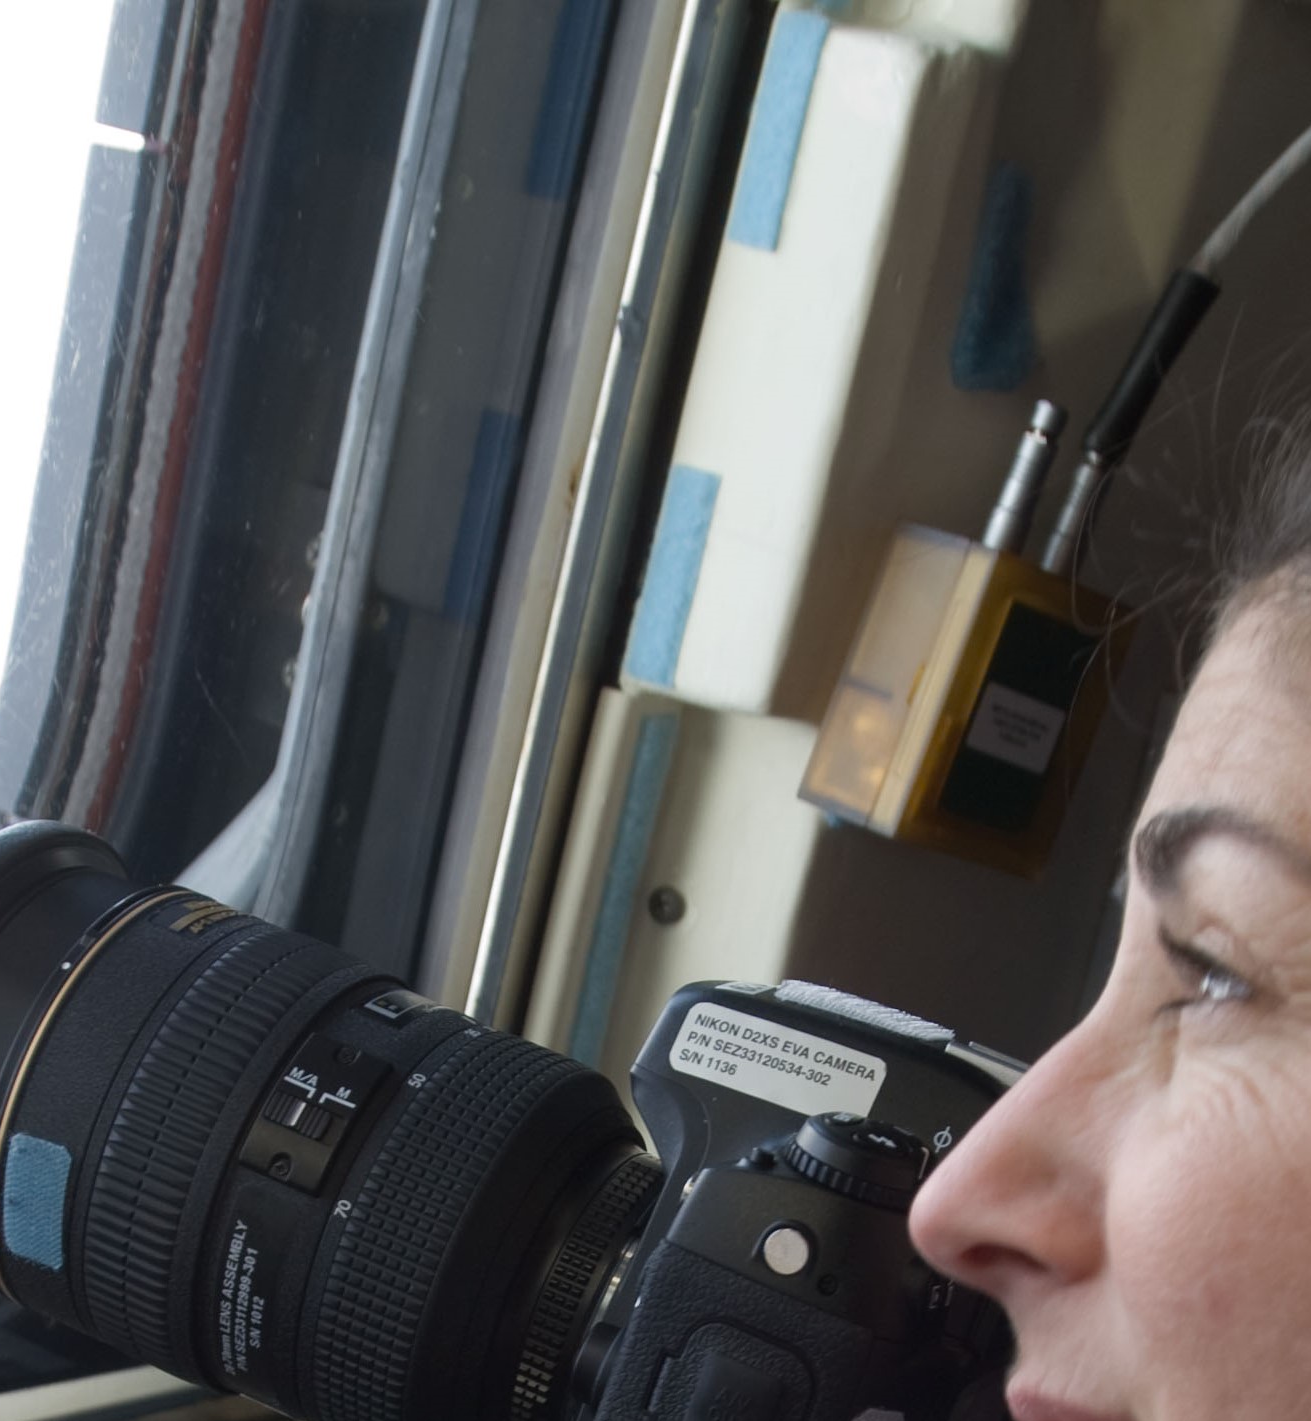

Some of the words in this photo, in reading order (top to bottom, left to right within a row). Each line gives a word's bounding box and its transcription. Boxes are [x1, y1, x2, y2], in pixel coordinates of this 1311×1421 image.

[686, 1031, 711, 1049] P/N
[712, 1038, 831, 1086] SEZ33120534-302
[694, 1013, 742, 1039] NIKON
[741, 1025, 779, 1049] D2XS
[781, 1041, 811, 1060] EVA
[812, 1051, 876, 1082] CAMERA
[679, 1048, 704, 1065] S/N
[706, 1056, 738, 1076] 1136
[289, 1066, 318, 1087] M/A
[407, 1072, 425, 1089] 50
[335, 1085, 352, 1100] M
[334, 1199, 353, 1219] 70
[222, 1218, 248, 1299] ASSEMBLY
[219, 1299, 232, 1334] LENS
[250, 1295, 265, 1325] 1012
[249, 1328, 261, 1349] S/N
